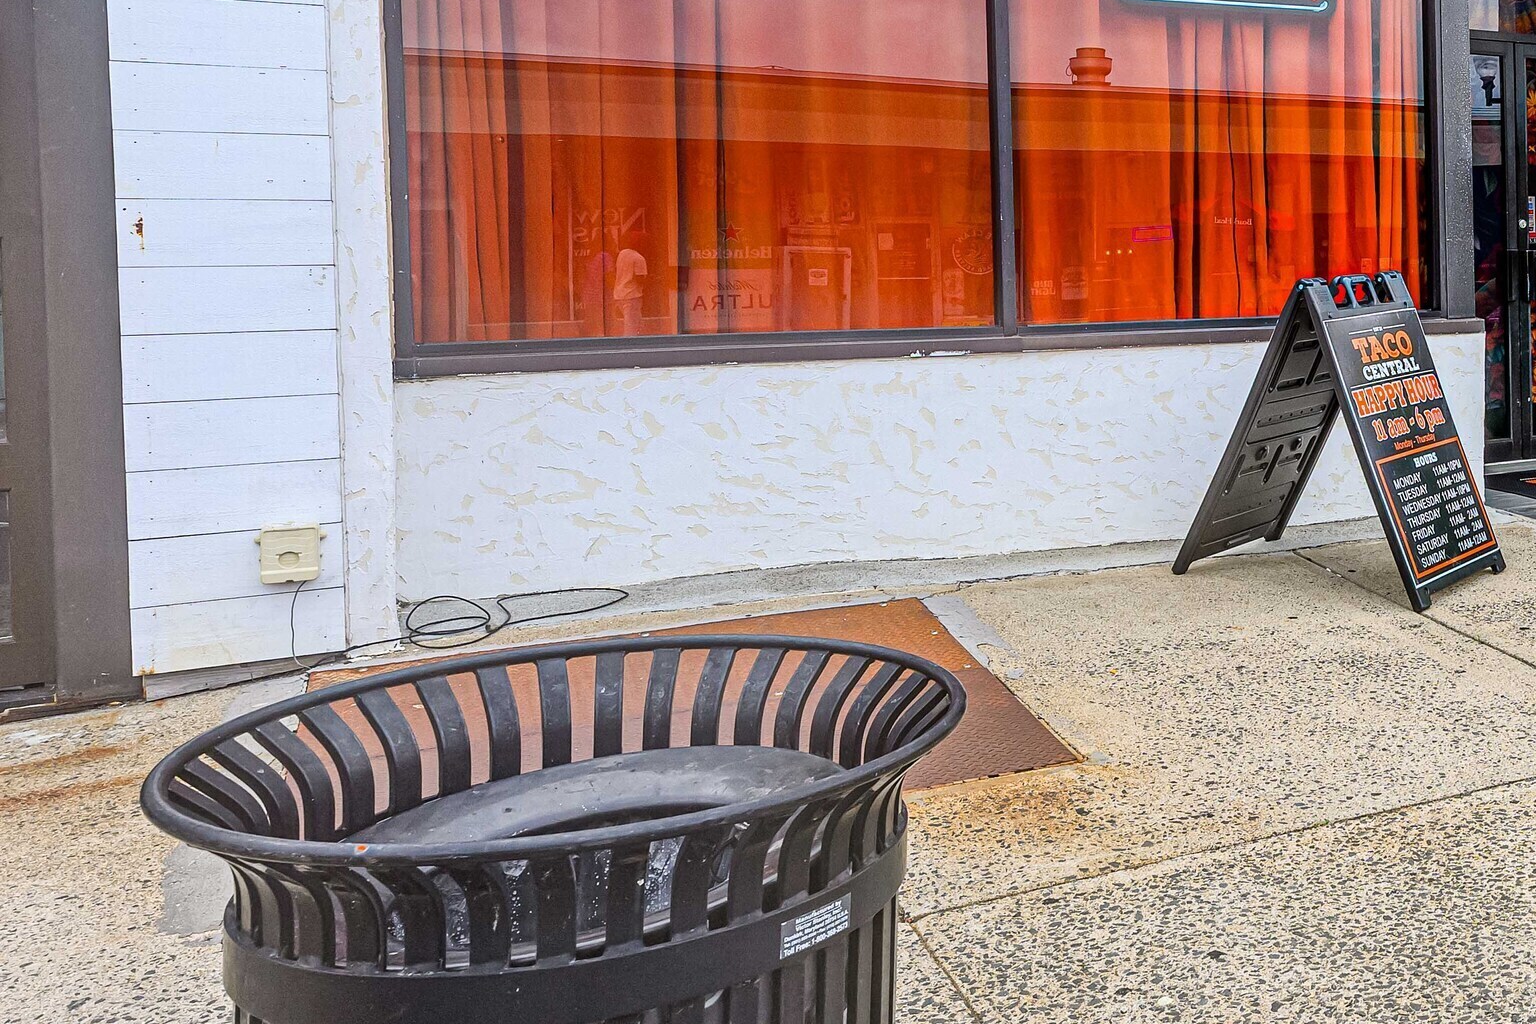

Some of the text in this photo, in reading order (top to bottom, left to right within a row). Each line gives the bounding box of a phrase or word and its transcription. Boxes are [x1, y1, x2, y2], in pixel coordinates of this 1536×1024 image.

[1351, 330, 1413, 364] TACO
[1362, 356, 1420, 381] CENTRAL
[1351, 374, 1443, 418] HAPPY HOUR
[1372, 418, 1388, 441] 11
[1387, 416, 1410, 438] am
[1415, 406, 1425, 429] 6
[1424, 407, 1445, 433] pm
[1394, 439, 1414, 450] Monday
[1415, 433, 1436, 444] Thursday
[1393, 458, 1462, 490] MONDAY 11AM-10PM
[1413, 452, 1438, 468] HOURS
[1397, 471, 1466, 503] TUESDAY 11AM-12AM
[1402, 482, 1471, 516] WEDNESDAY 11AM-10PM
[1407, 495, 1475, 528] THURSDAY 11AM-12AM
[1411, 524, 1436, 542] FRIDAY
[1467, 507, 1479, 520] 2AM
[1416, 533, 1449, 555] SATURDAY
[1471, 519, 1484, 532] 2AM
[1421, 531, 1487, 568] SUNDAY 11AM-12AM
[783, 946, 795, 957] Toll
